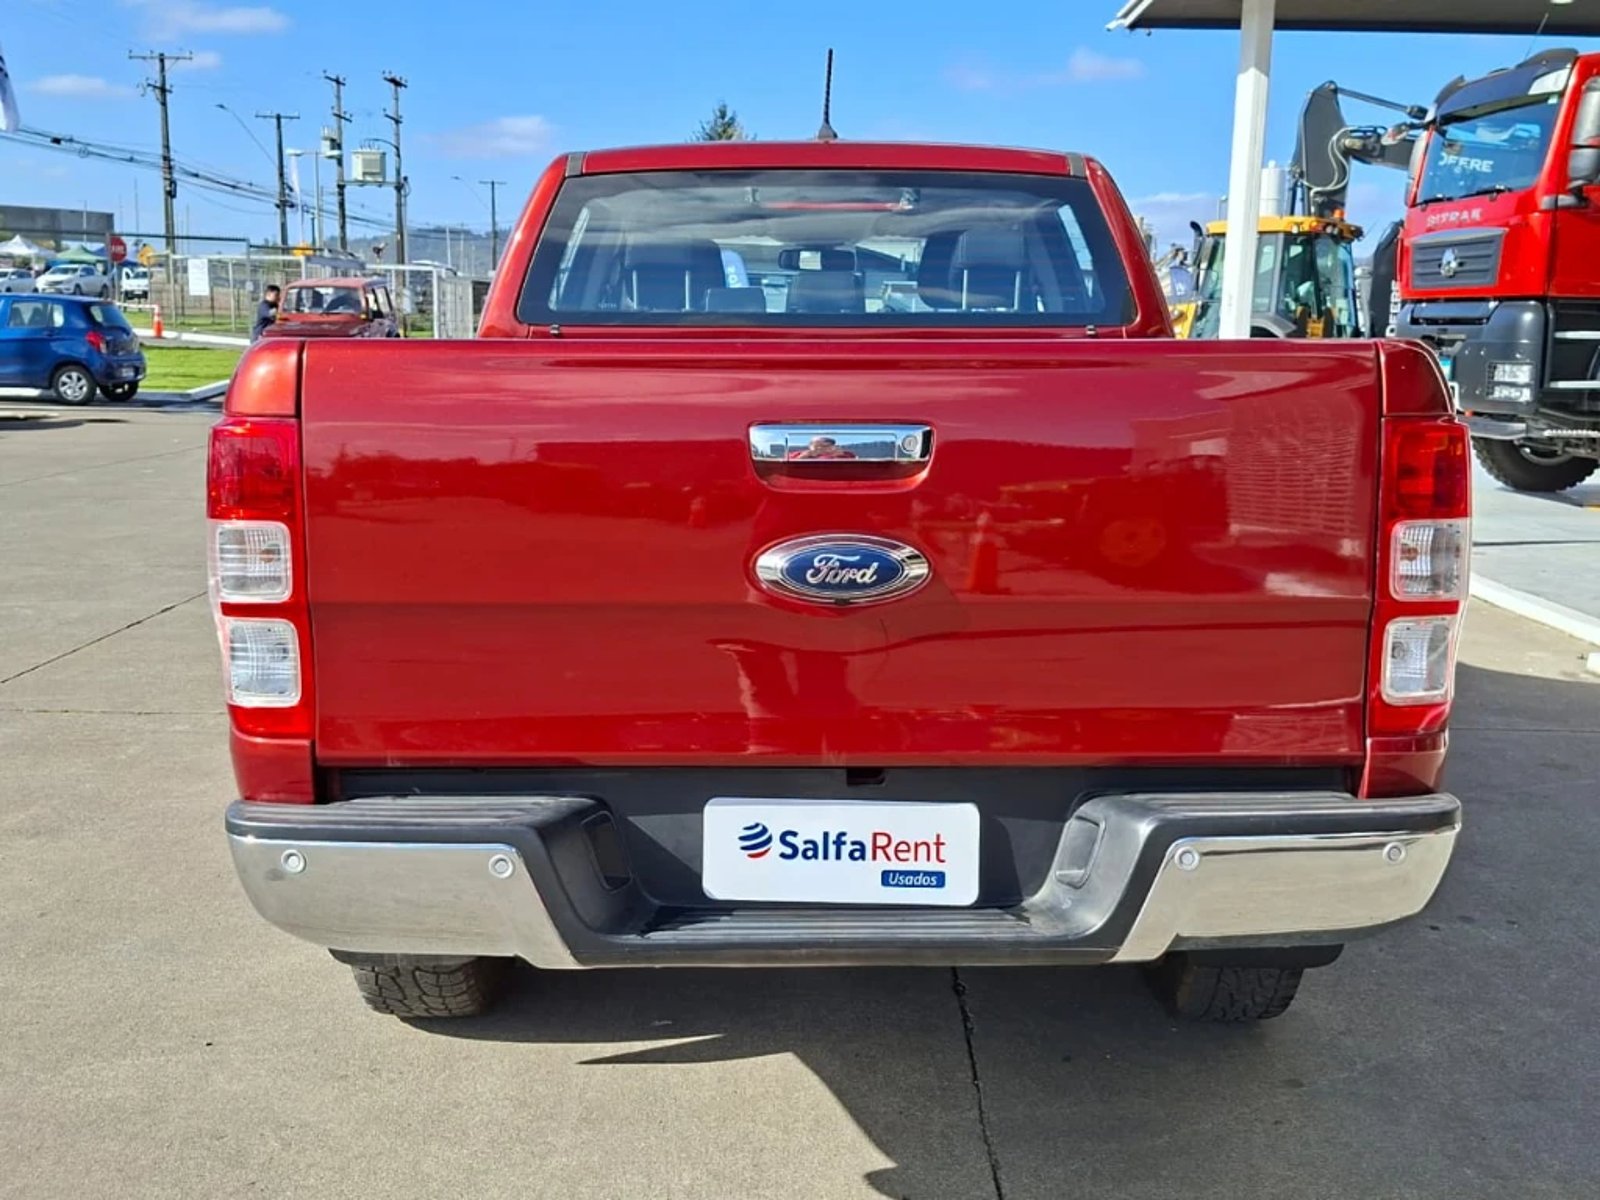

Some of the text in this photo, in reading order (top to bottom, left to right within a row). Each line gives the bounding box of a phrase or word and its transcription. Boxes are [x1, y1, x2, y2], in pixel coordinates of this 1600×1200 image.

[805, 553, 880, 585] Ford
[778, 829, 947, 863] SalfaRent
[888, 872, 938, 886] Usados
